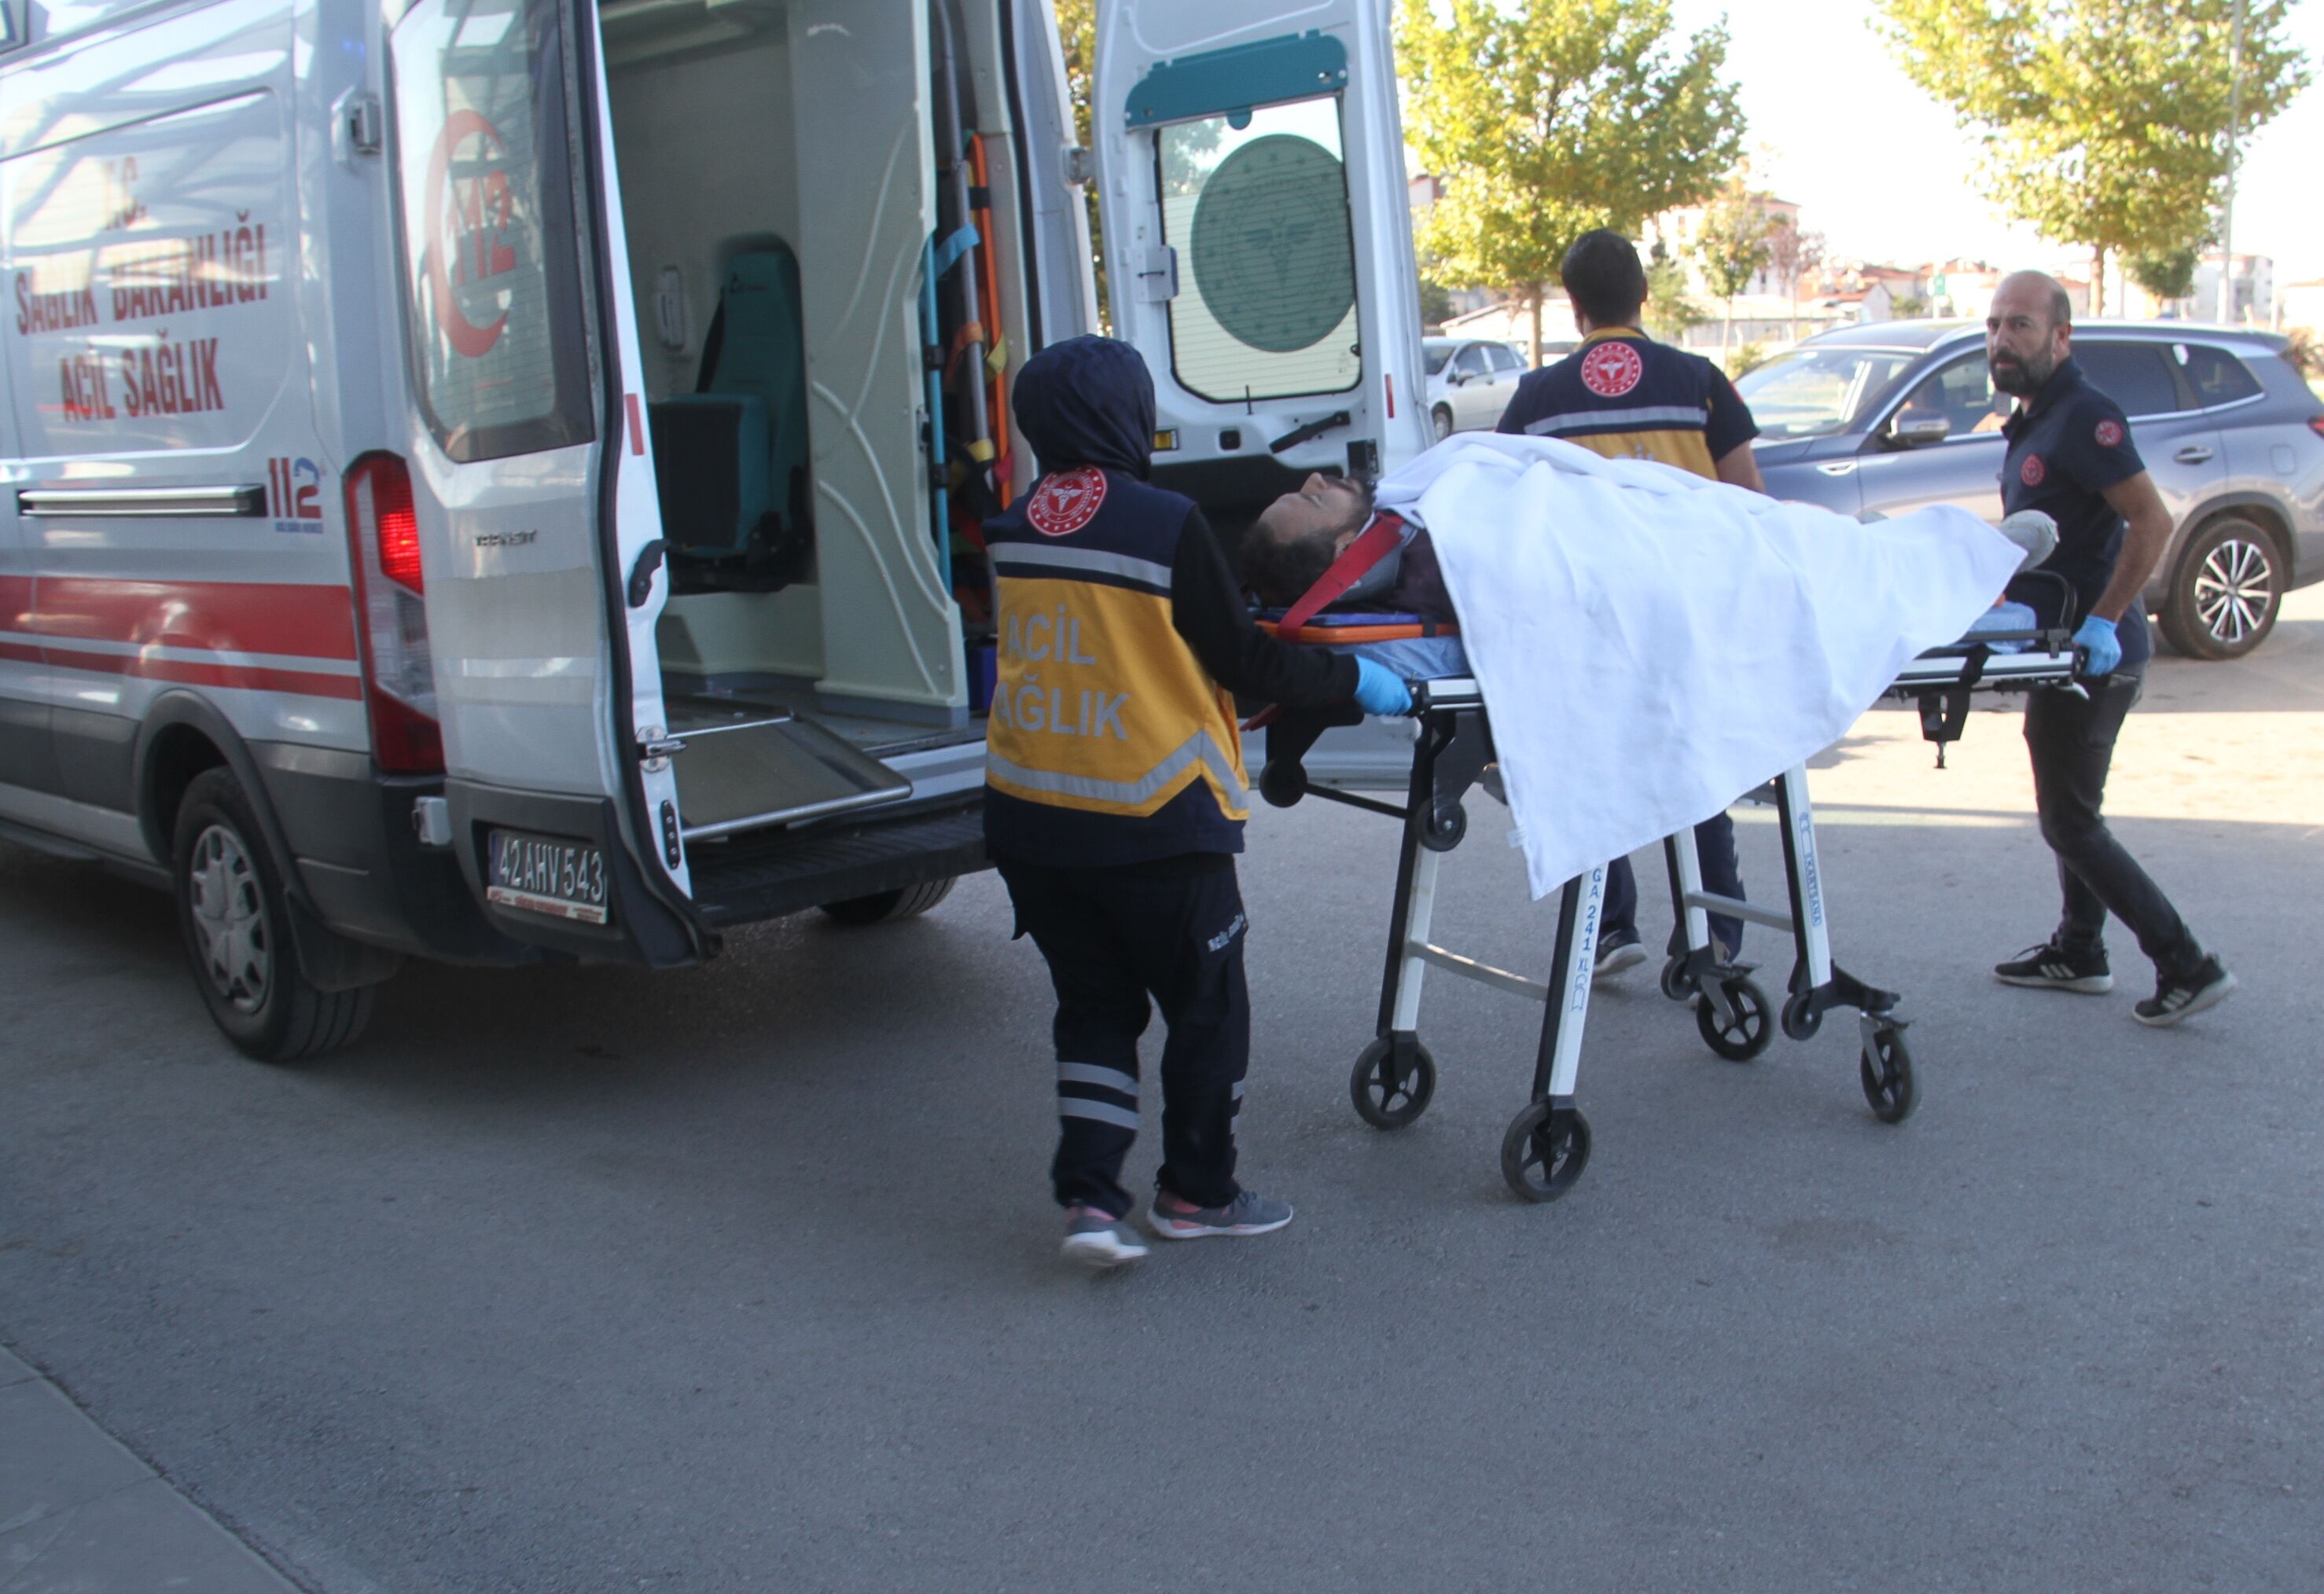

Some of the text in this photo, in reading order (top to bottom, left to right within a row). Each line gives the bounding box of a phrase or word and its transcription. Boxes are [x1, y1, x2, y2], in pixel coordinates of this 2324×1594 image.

[122, 328, 225, 417] SAĞLIK
[268, 457, 323, 519] 112
[1006, 604, 1095, 665] ACİL
[994, 670, 1130, 740] AĞLIK
[499, 836, 604, 902] 42 AHV 543
